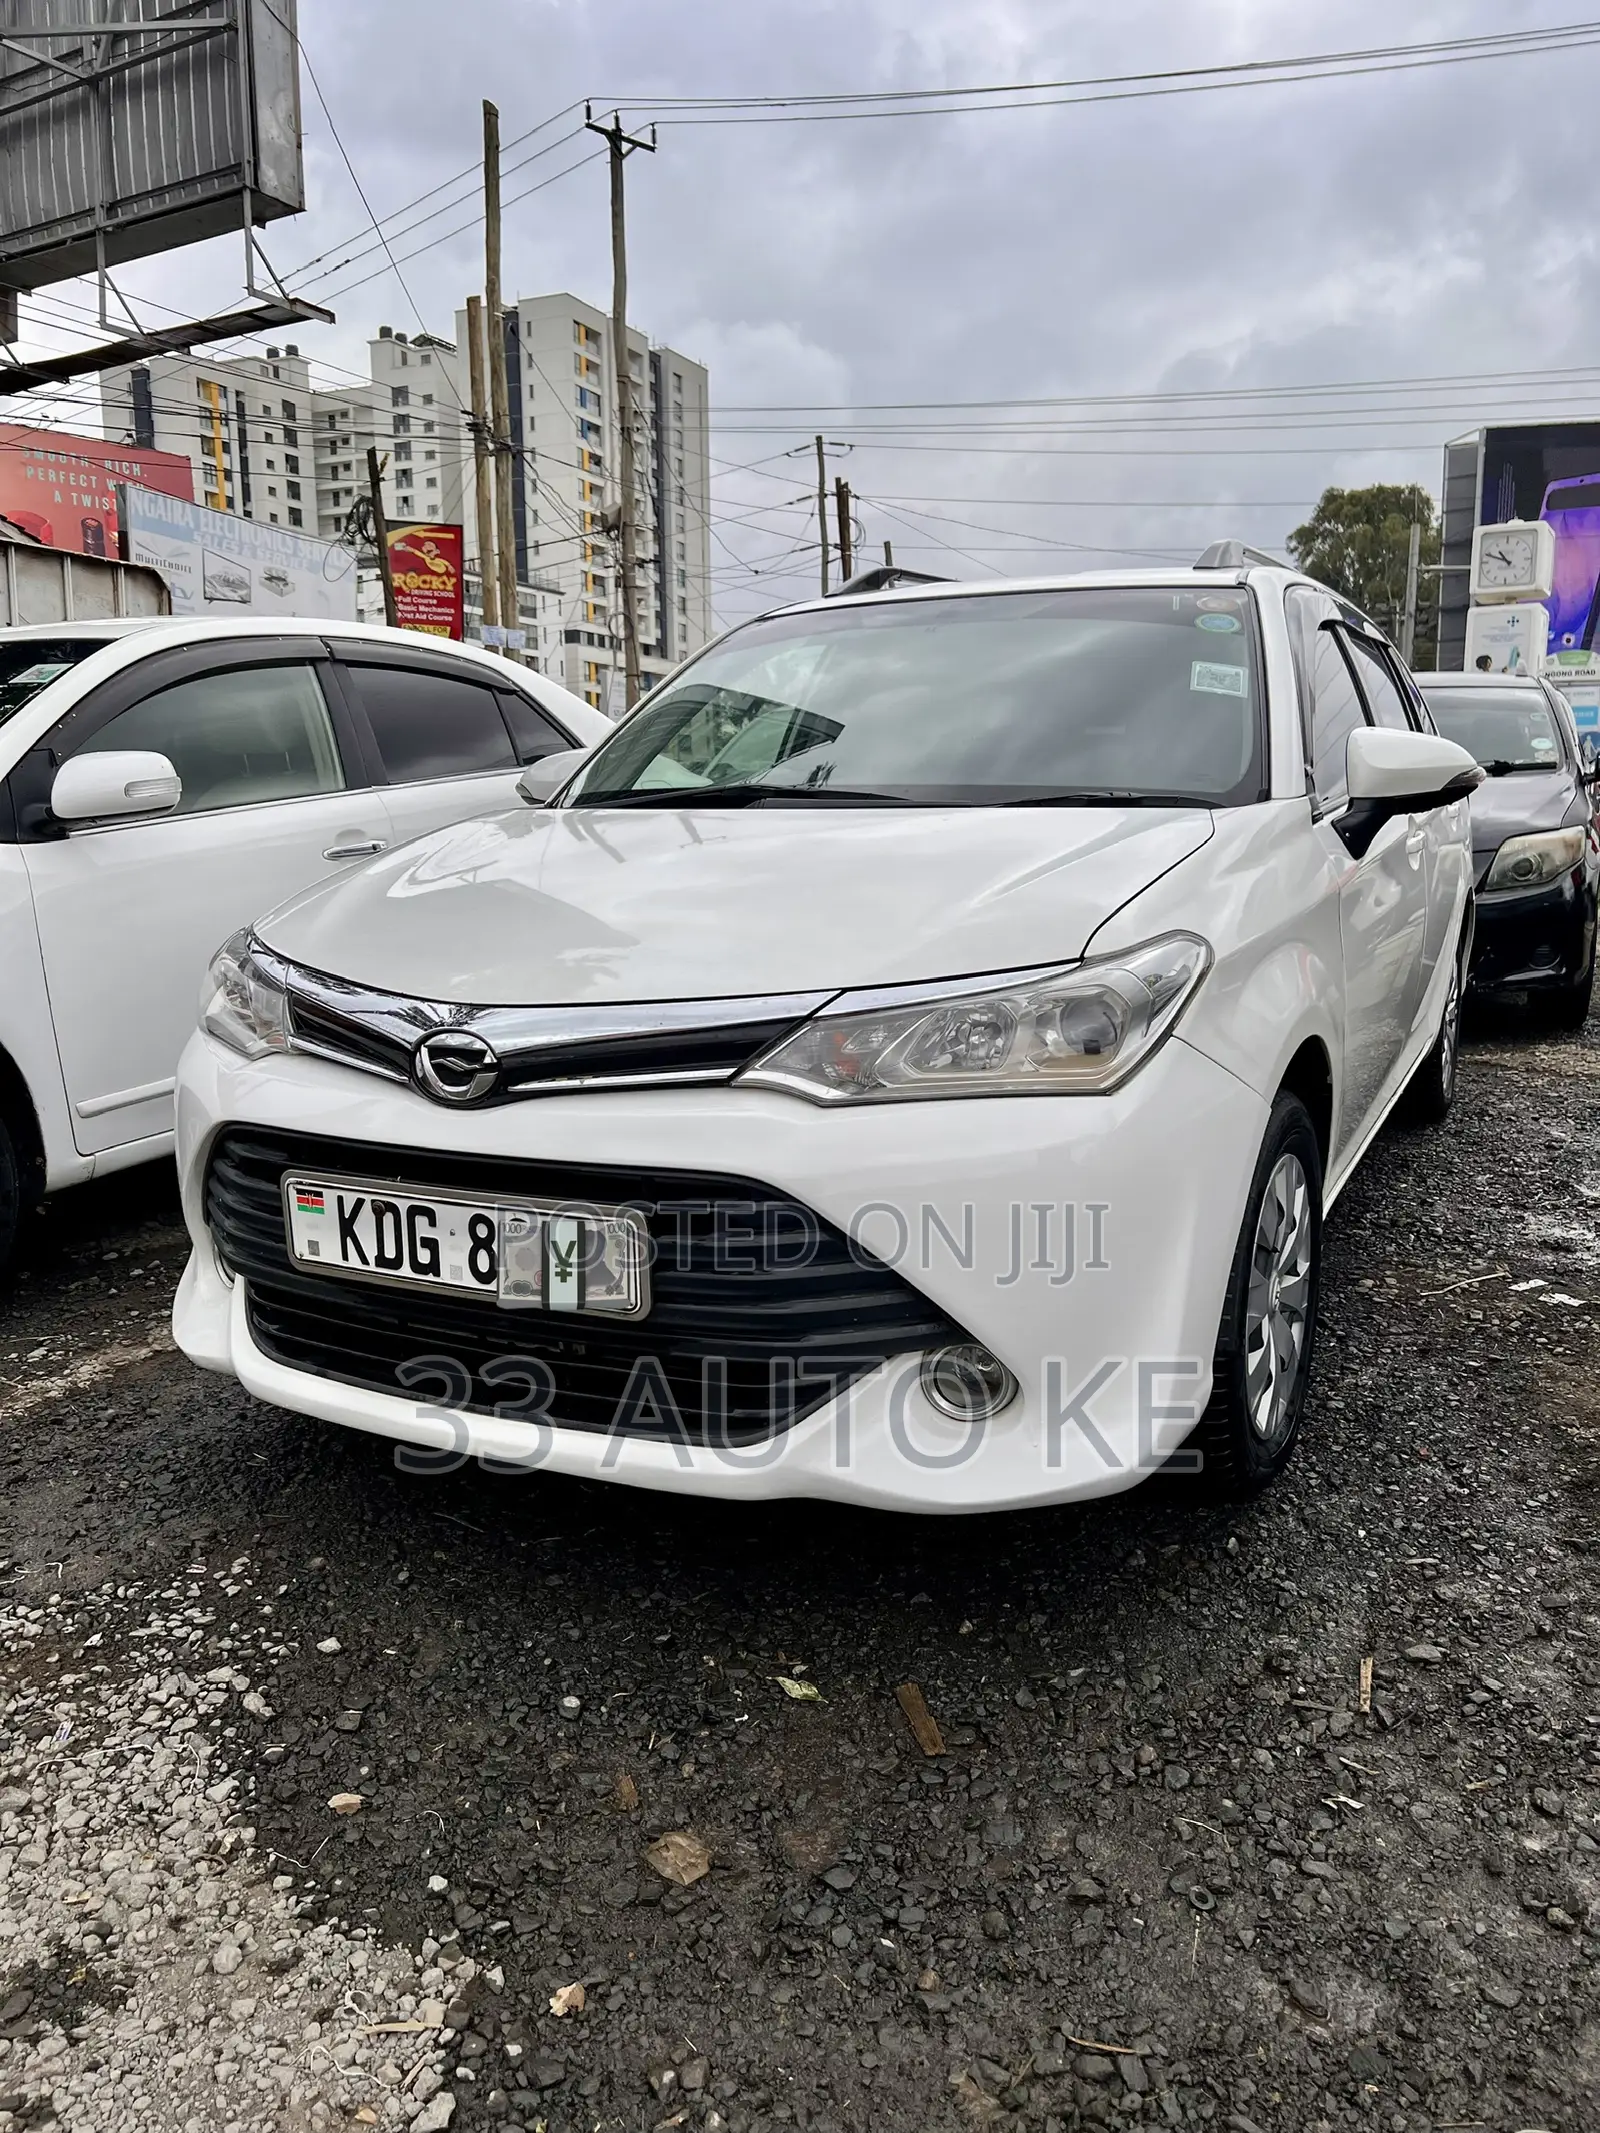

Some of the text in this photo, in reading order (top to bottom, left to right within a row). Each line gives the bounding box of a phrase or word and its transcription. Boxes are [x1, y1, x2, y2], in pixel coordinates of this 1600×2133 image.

[26, 466, 97, 488] PERFECT
[54, 491, 62, 503] A
[193, 530, 240, 556] SALES
[391, 571, 457, 594] ROCKY
[1574, 668, 1596, 677] ROAD
[336, 1194, 441, 1278] KDG
